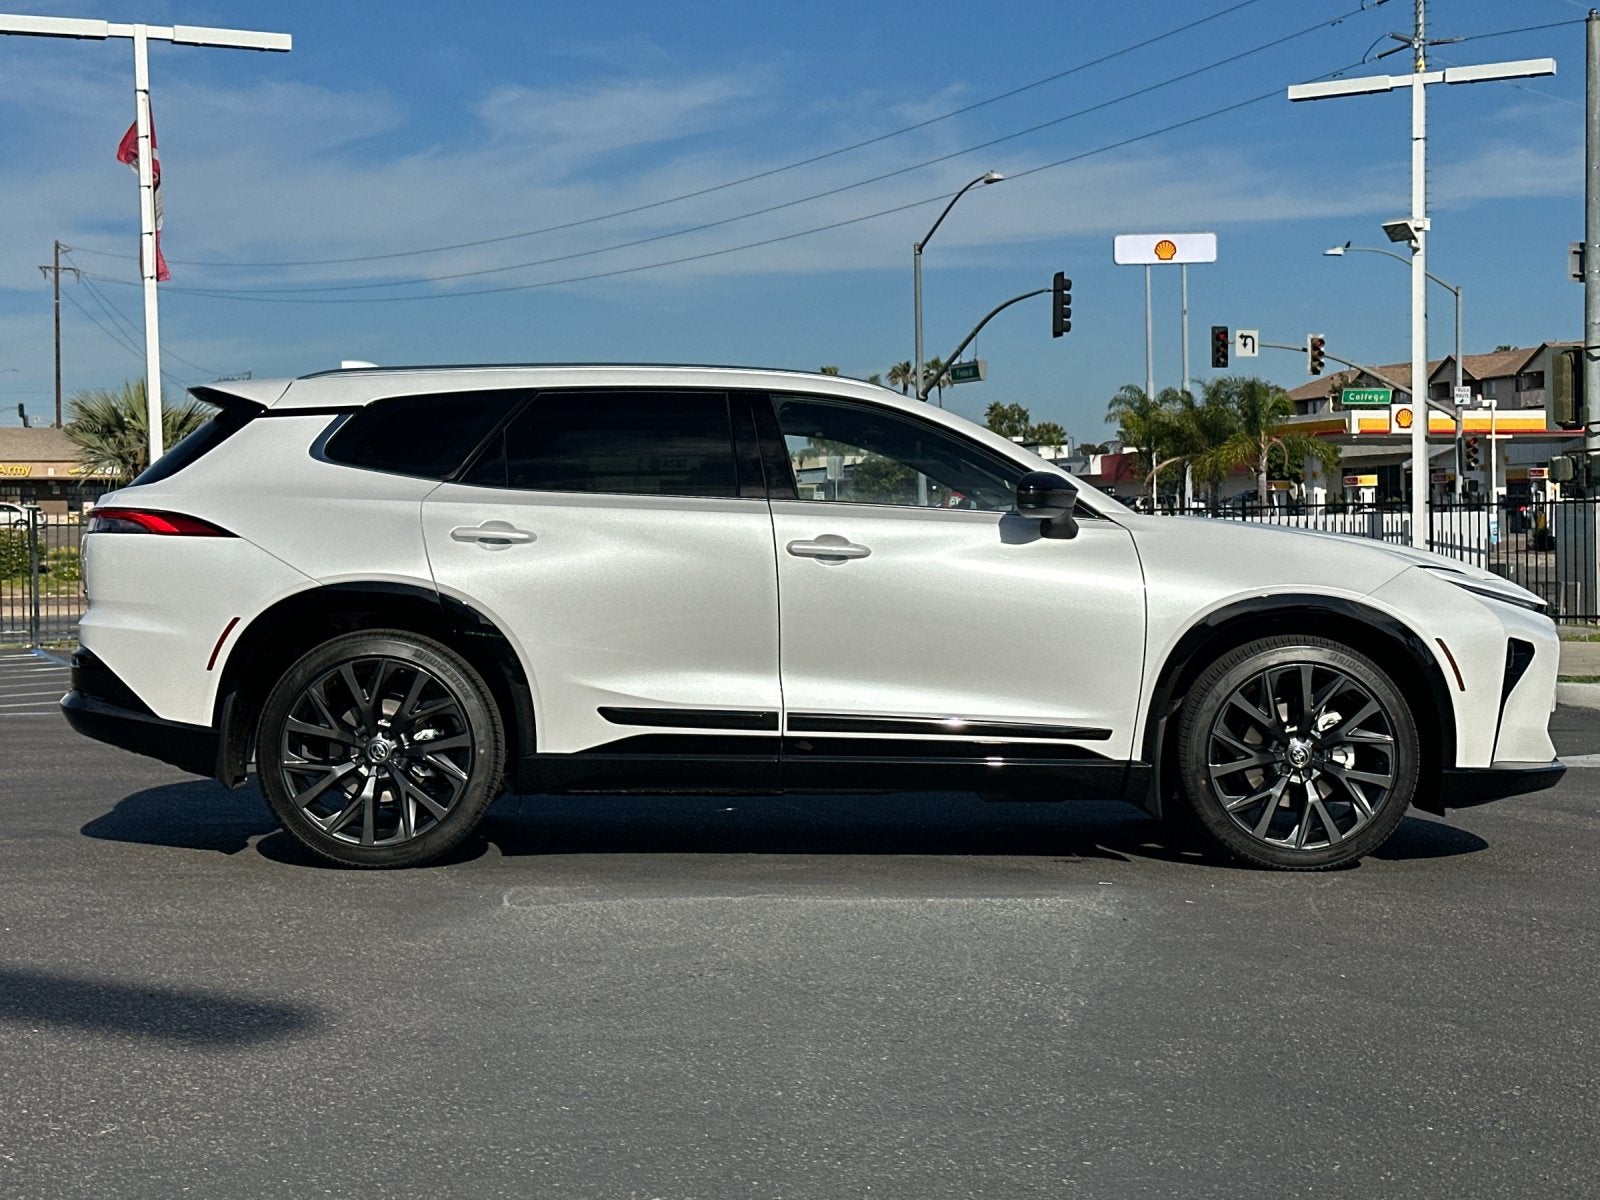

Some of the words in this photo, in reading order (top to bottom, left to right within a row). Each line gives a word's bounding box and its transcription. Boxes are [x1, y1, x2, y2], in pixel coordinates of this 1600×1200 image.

[1349, 392, 1385, 403] College
[412, 649, 474, 701] BRIDGESTONE
[1327, 652, 1393, 699] BRIDGESTONE
